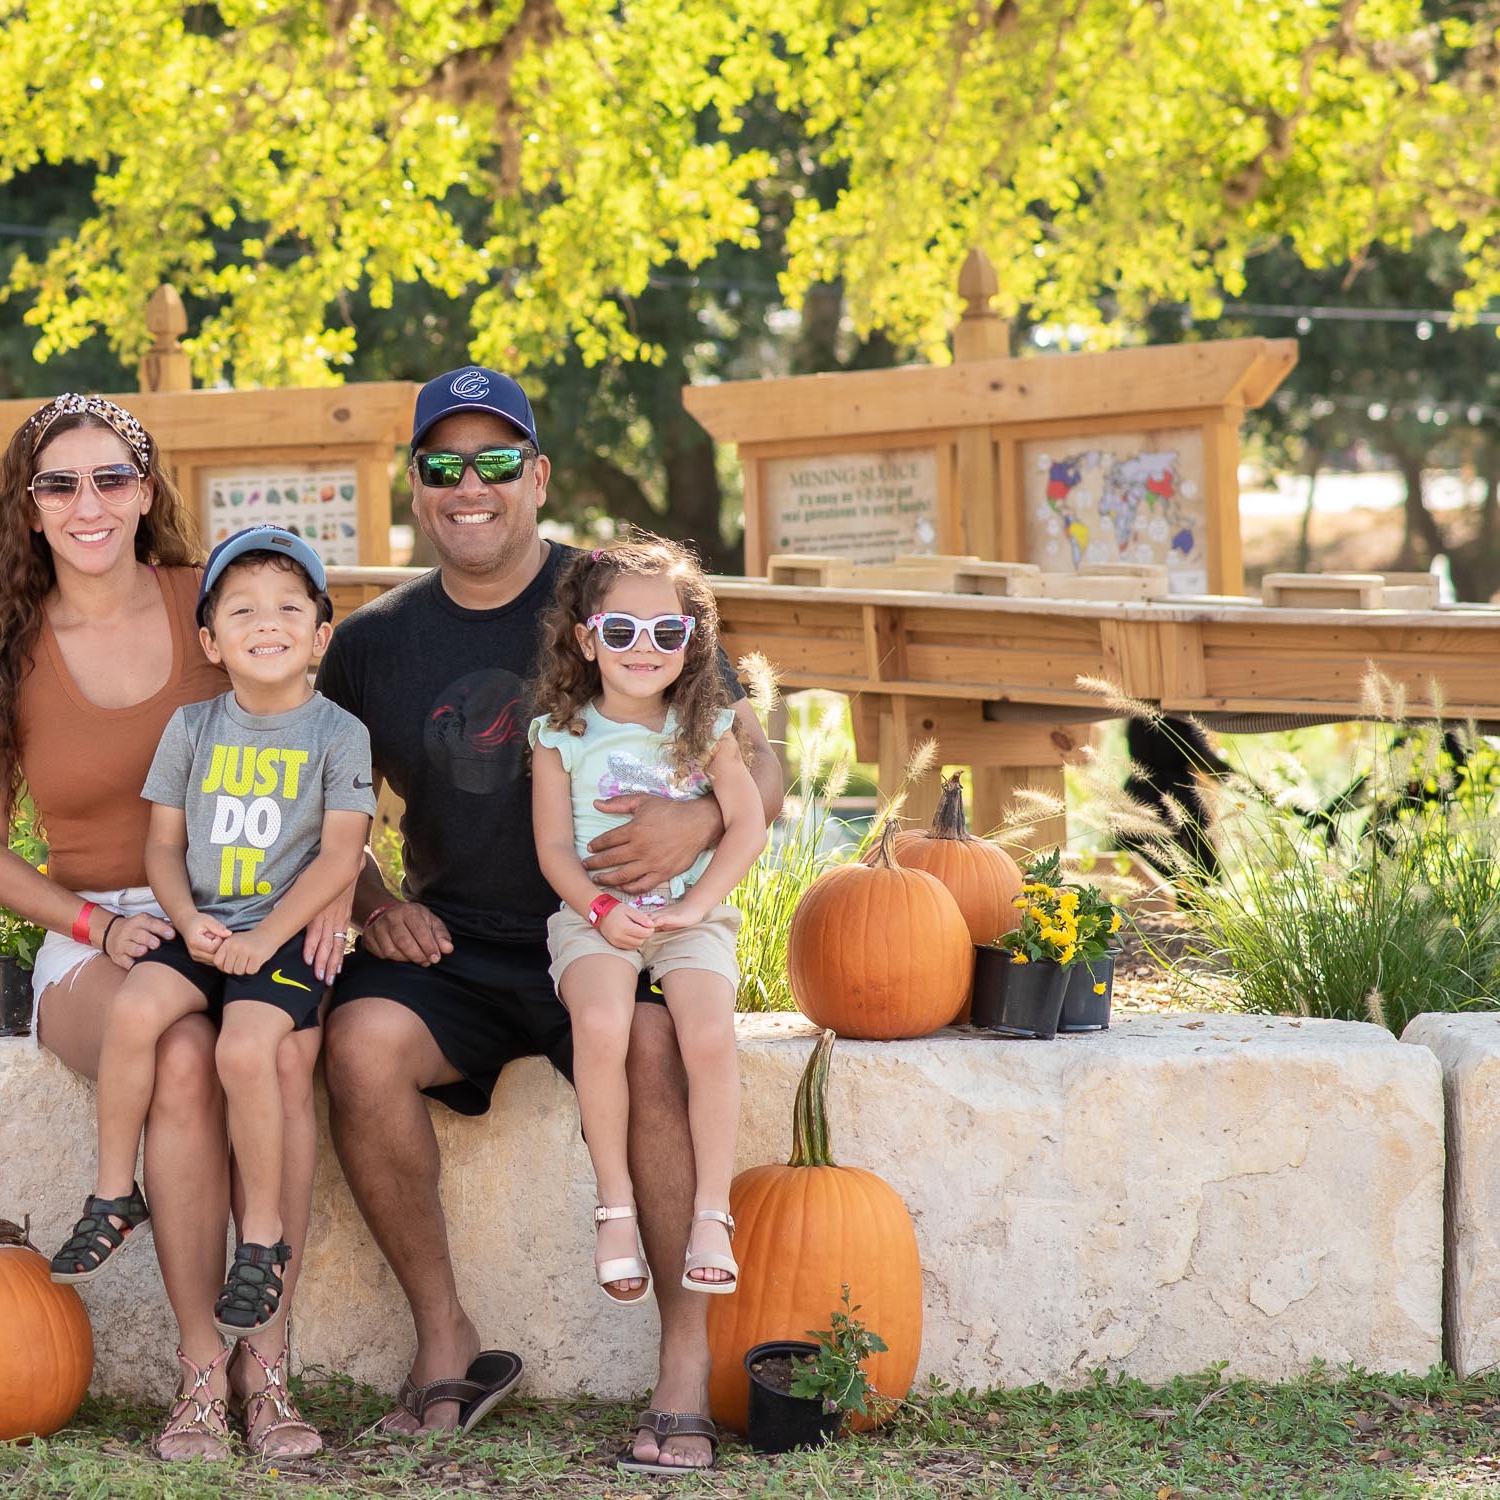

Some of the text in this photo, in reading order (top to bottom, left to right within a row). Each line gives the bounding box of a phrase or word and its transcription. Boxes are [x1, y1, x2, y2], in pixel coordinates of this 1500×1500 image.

[790, 464, 918, 487] MINING SLUICE
[201, 744, 309, 800] JUST
[210, 795, 282, 848] DO
[219, 846, 272, 896] IT.
